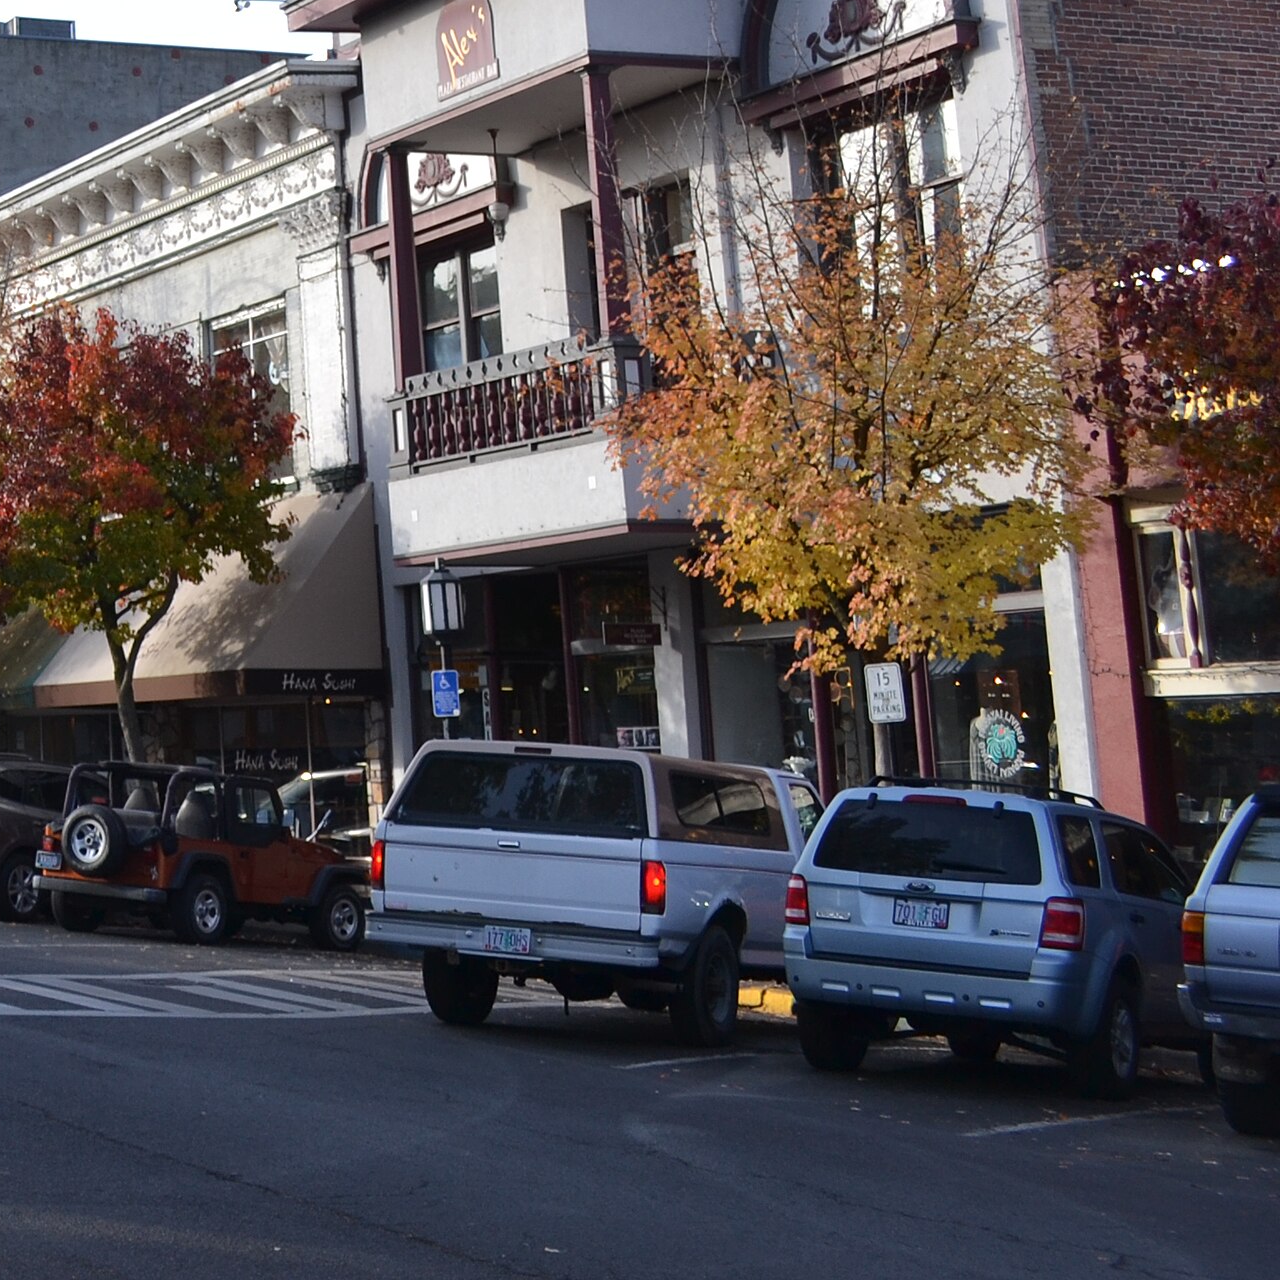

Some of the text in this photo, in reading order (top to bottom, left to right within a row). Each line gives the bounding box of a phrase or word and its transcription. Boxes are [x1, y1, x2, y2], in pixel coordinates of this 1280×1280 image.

[441, 5, 485, 91] Alex's
[877, 672, 890, 686] 15
[873, 704, 901, 714] PARKING
[897, 903, 947, 922] 701 FGU
[487, 931, 504, 945] 177
